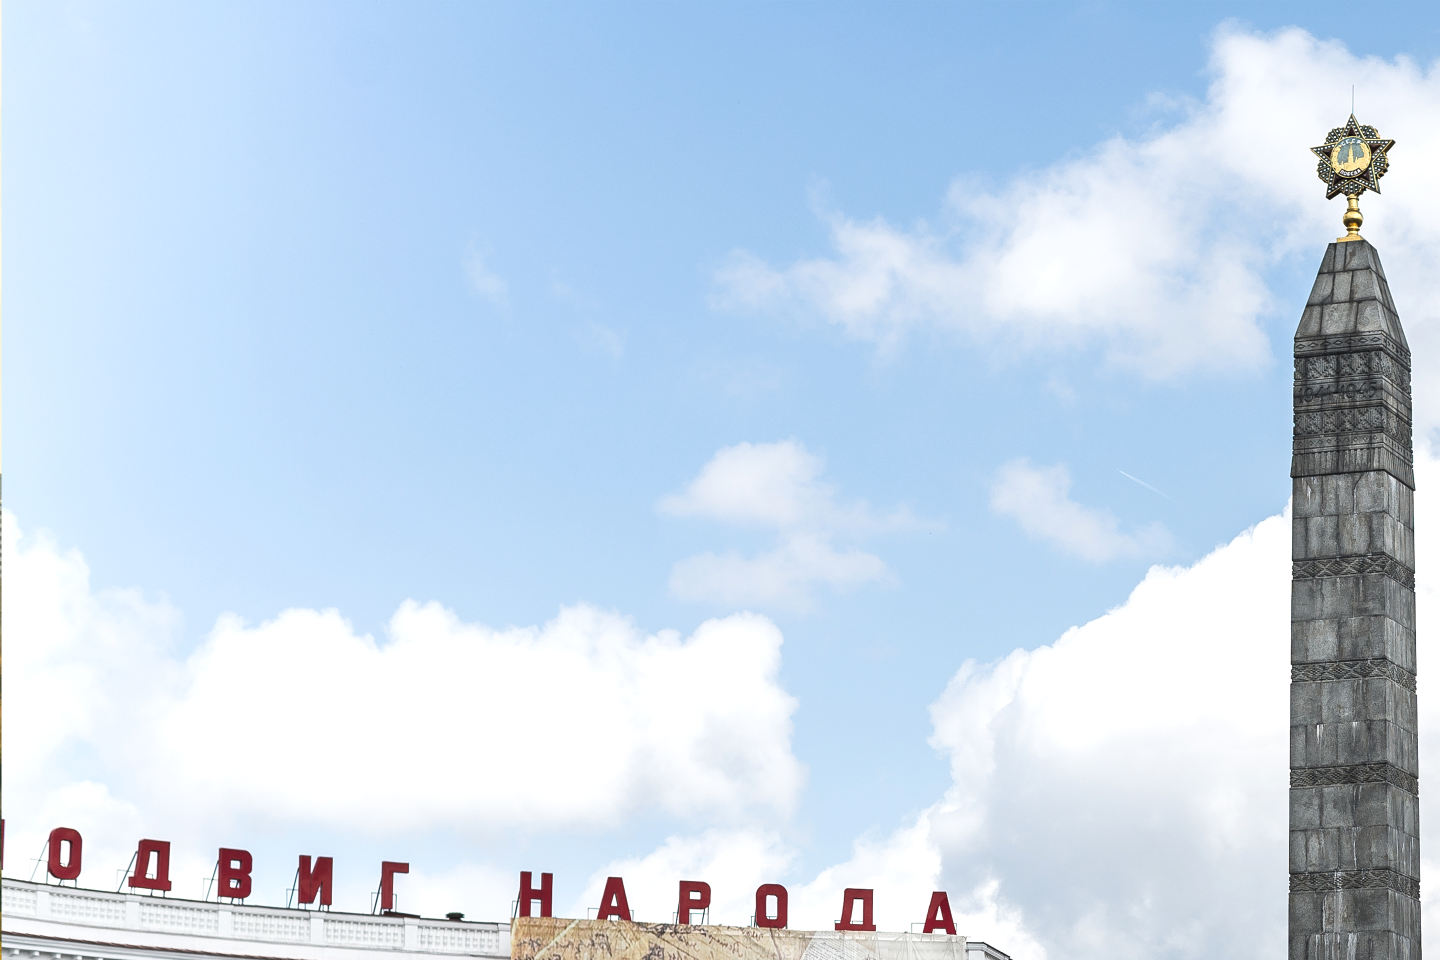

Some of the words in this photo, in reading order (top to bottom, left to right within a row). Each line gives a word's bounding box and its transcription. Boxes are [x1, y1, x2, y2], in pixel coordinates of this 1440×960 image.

[1298, 385, 1331, 404] 1941
[1340, 381, 1378, 400] 1945
[1, 819, 410, 911] ОДВИГ
[519, 871, 957, 935] НАРОДА
